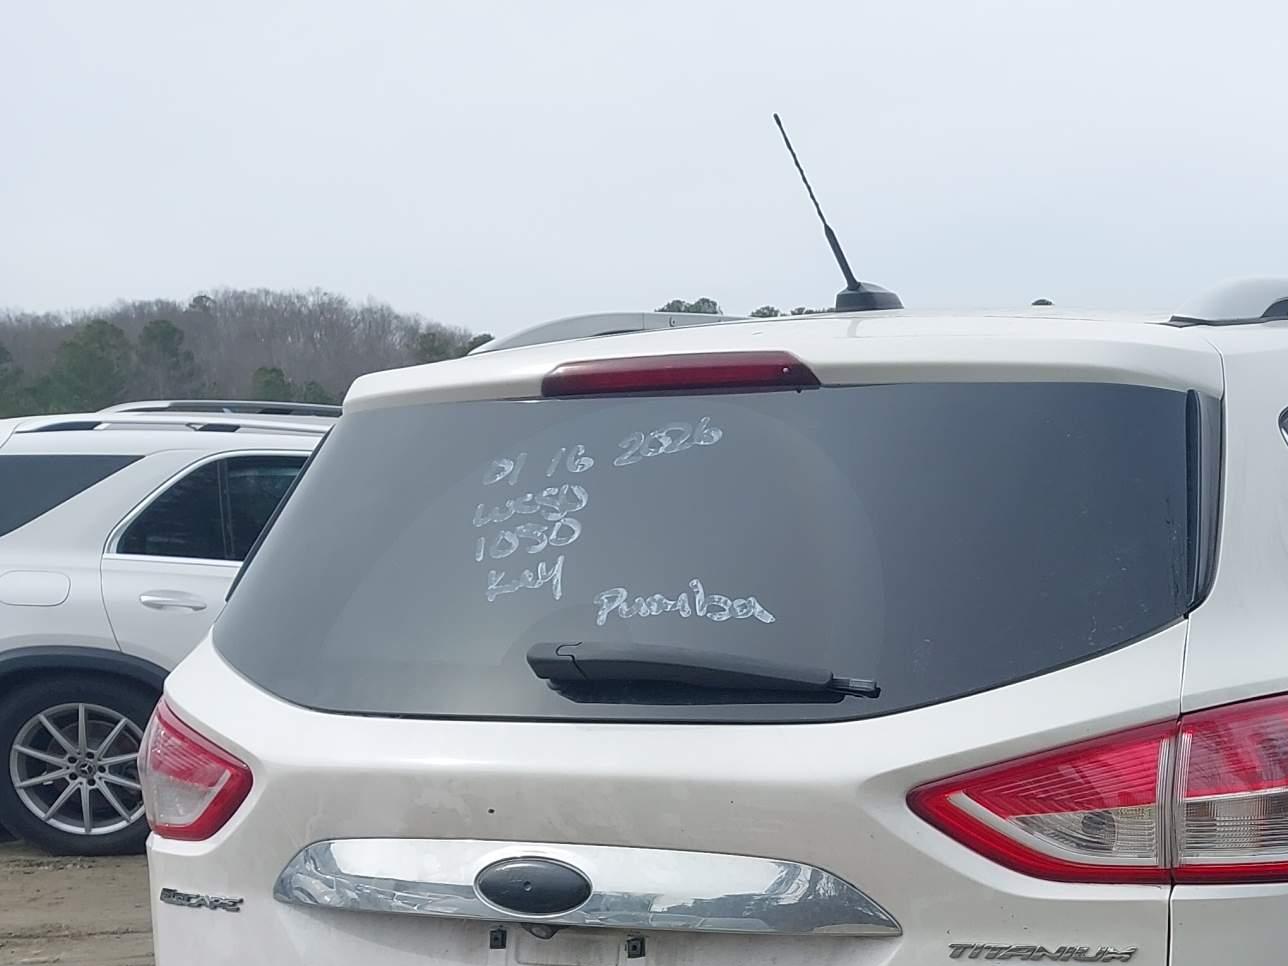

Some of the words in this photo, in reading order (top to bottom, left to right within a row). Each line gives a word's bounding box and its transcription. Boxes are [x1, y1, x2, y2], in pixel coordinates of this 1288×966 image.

[545, 444, 594, 477] 16
[613, 416, 723, 466] 2026
[948, 943, 1138, 963] TITANIUM
